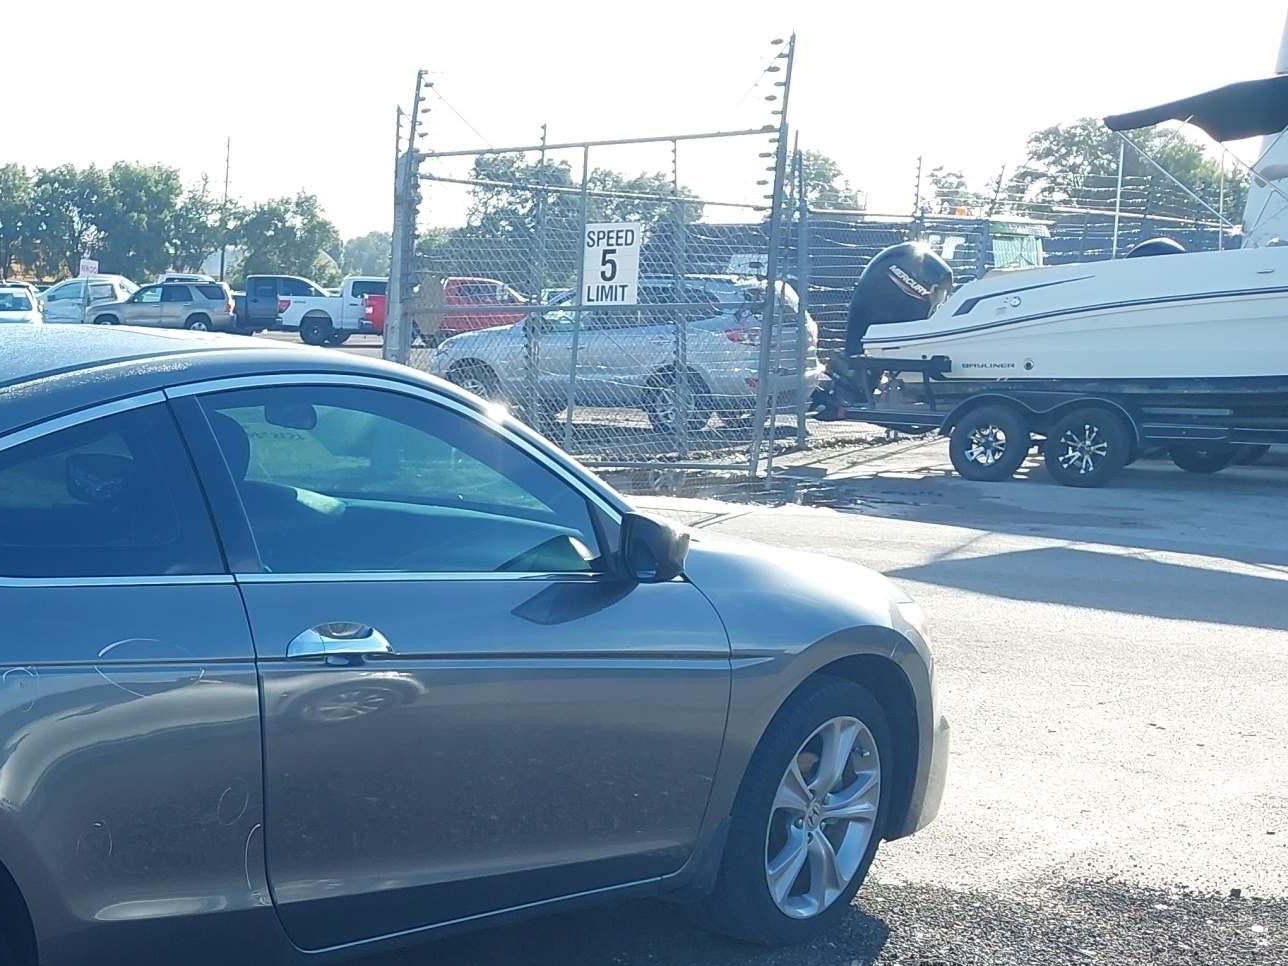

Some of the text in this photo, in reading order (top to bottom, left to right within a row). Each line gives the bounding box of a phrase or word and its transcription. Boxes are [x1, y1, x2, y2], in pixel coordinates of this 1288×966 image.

[586, 229, 635, 248] SPEED
[600, 248, 617, 282] 5
[888, 264, 931, 296] MERCURY
[586, 284, 629, 302] LIMIT
